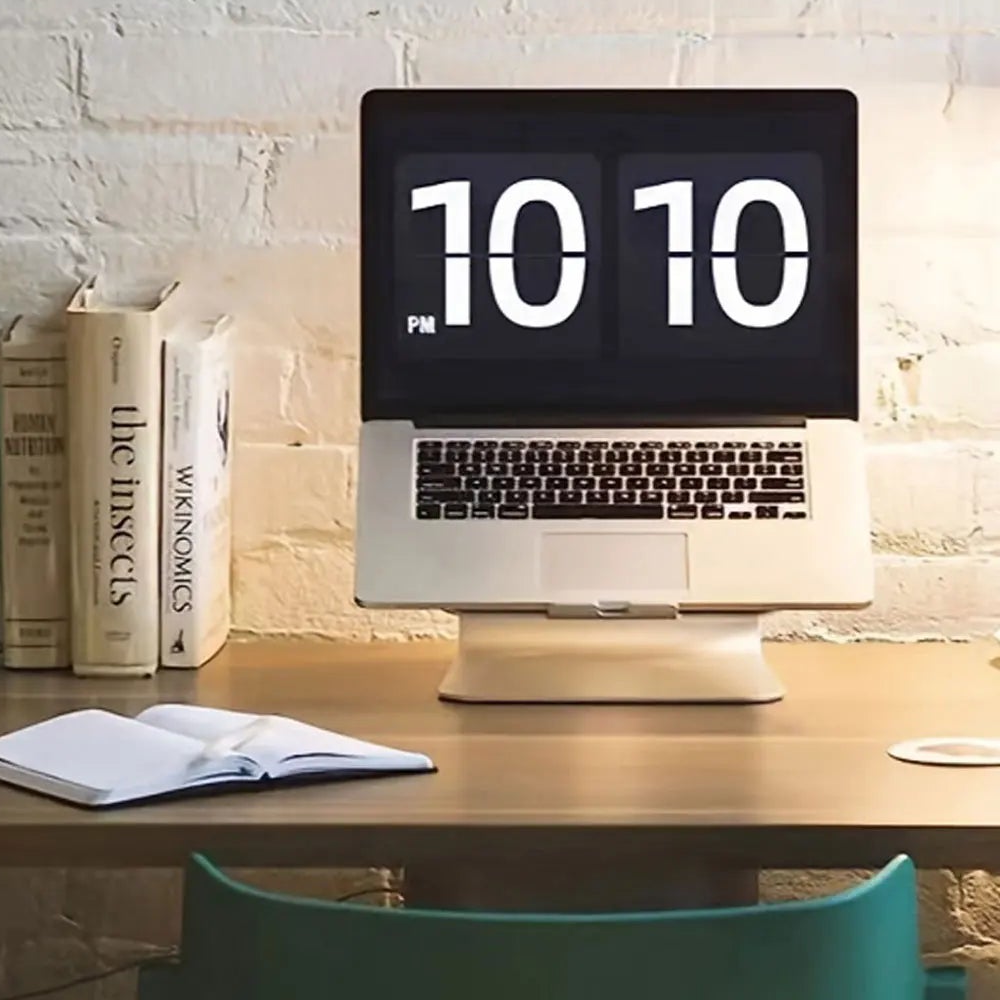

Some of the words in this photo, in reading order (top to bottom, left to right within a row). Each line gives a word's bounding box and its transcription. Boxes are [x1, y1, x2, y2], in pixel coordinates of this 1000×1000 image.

[410, 178, 587, 328] 10
[634, 178, 810, 329] 10
[407, 314, 437, 334] PM
[109, 405, 148, 467] the
[109, 477, 140, 607] insects
[170, 464, 194, 614] WIKINOMICS
